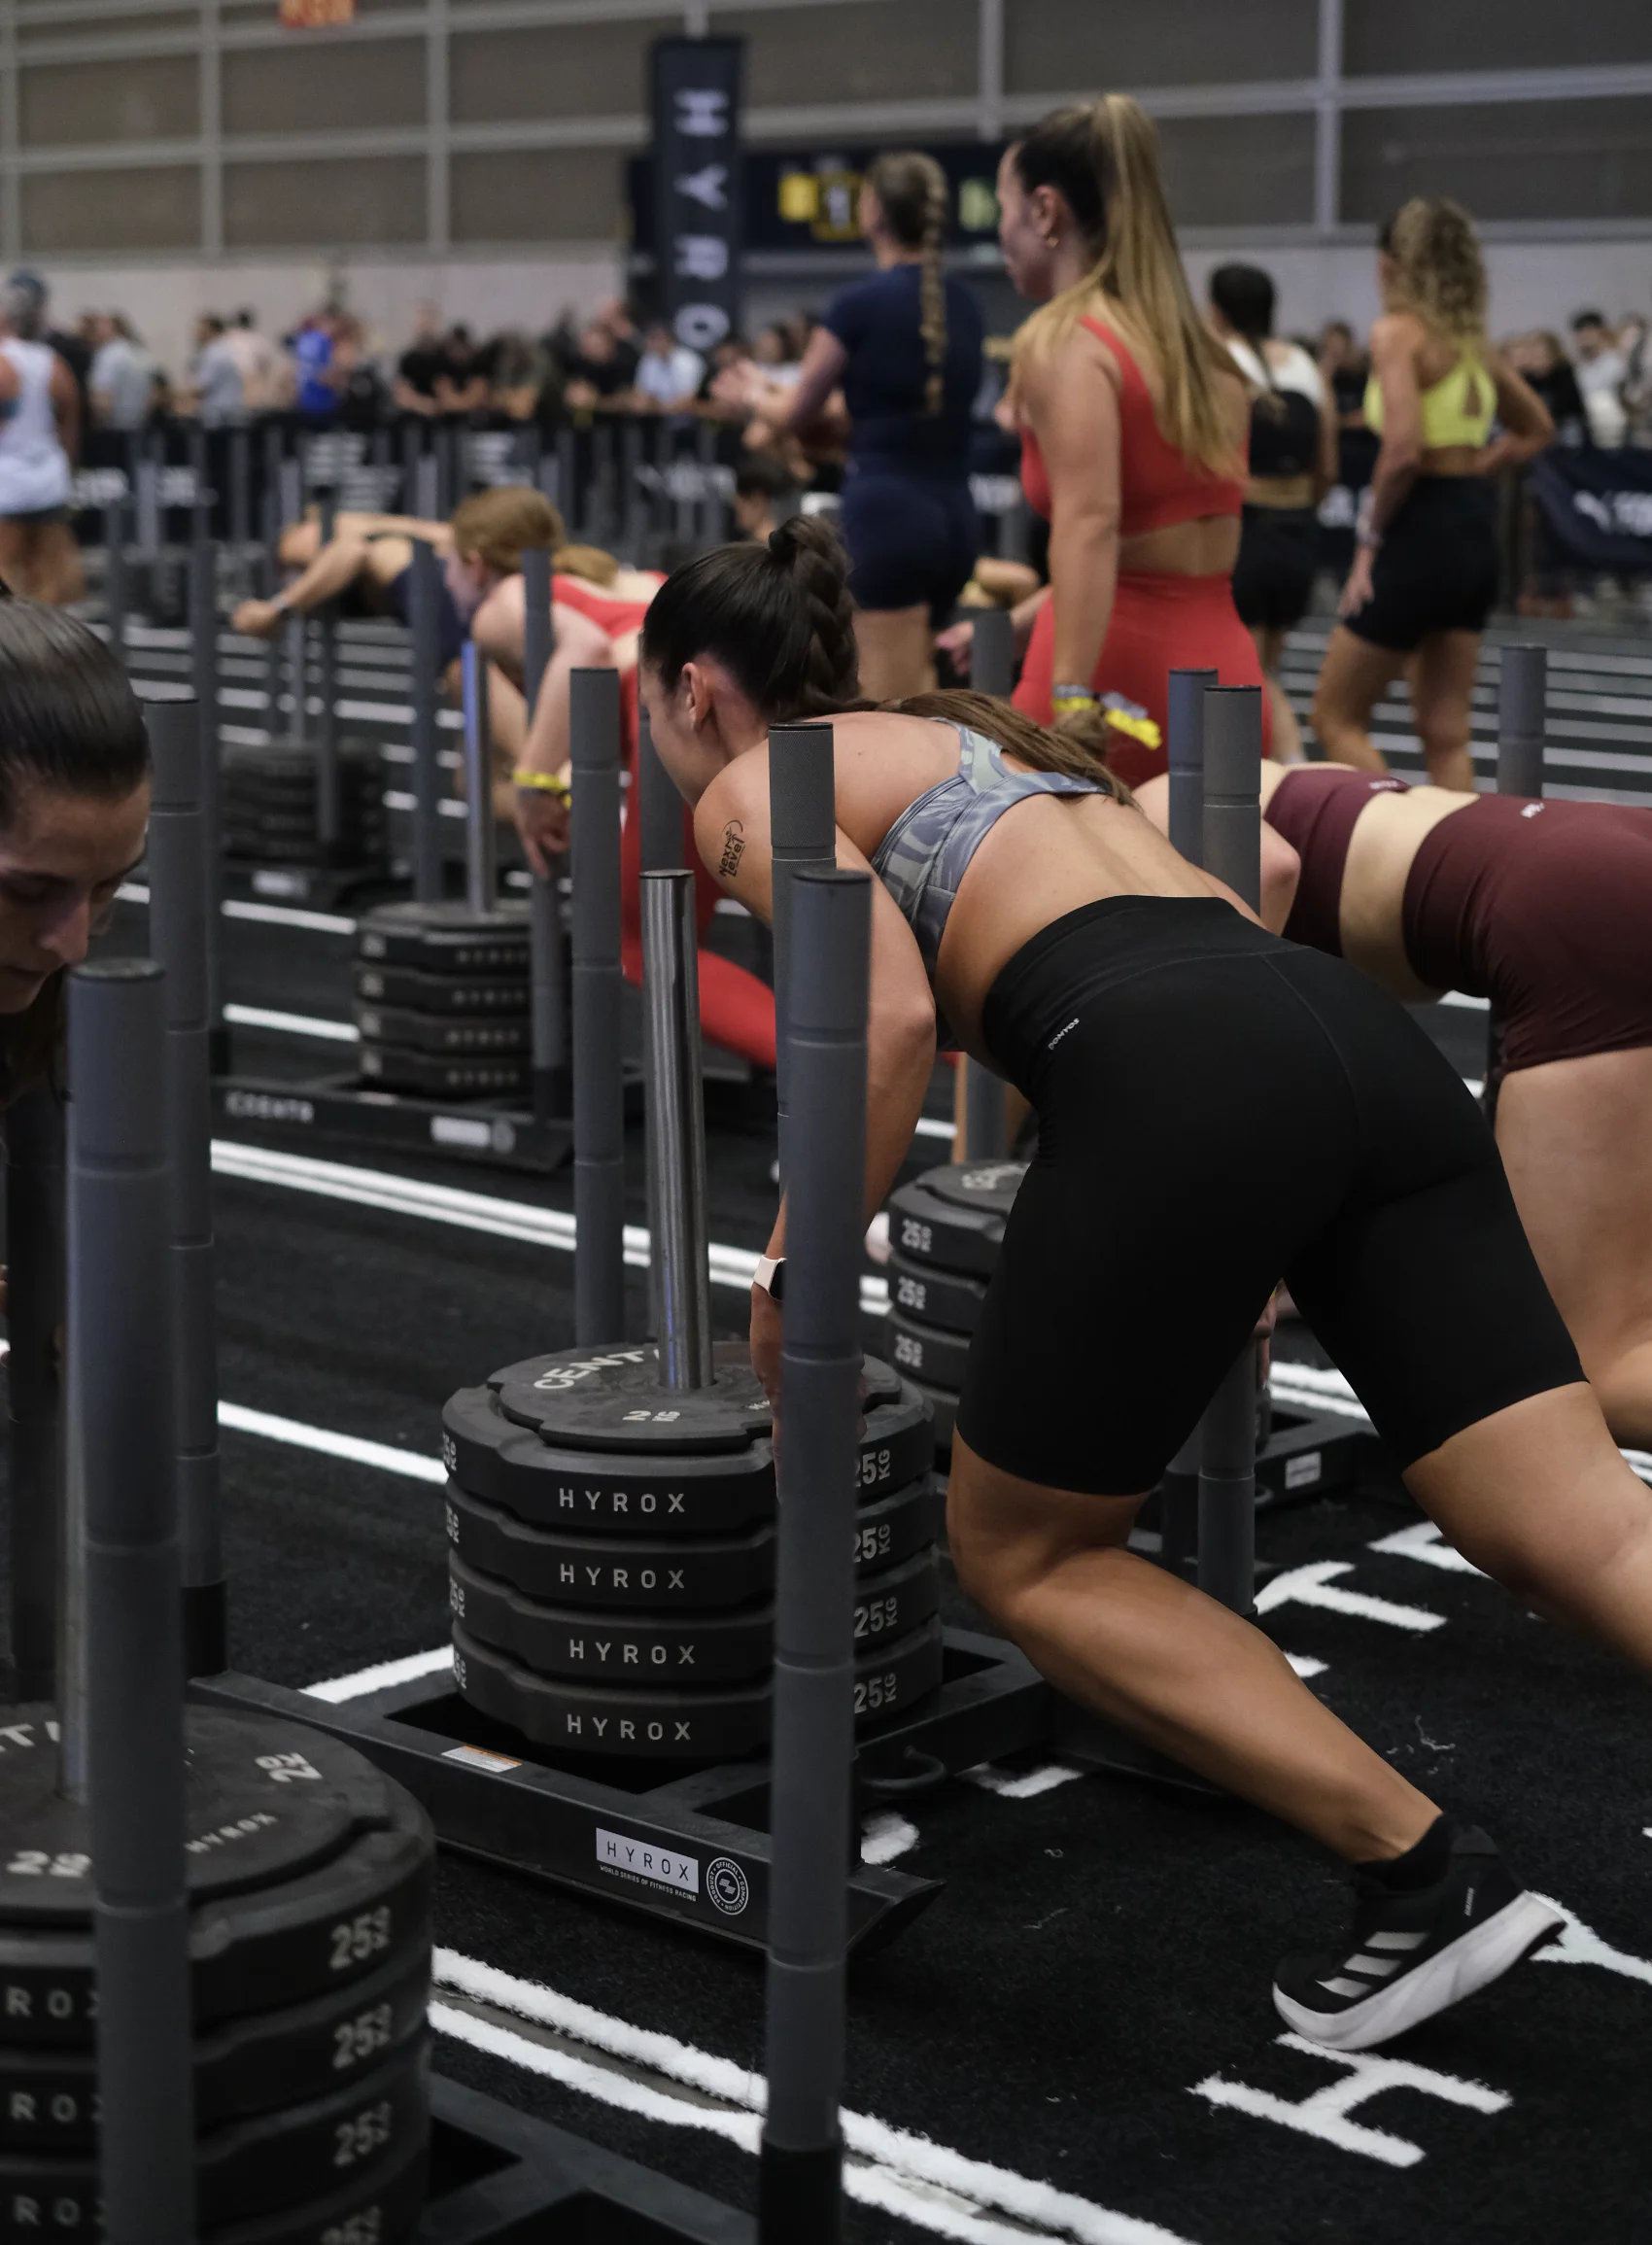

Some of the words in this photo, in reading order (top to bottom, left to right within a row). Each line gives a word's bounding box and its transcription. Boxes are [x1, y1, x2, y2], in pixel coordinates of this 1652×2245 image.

[675, 89, 730, 348] HYRO
[727, 836, 745, 878] Level
[533, 1348, 660, 1390] CENT
[559, 1487, 685, 1513] HYROX
[560, 1563, 685, 1589] HYROX
[569, 1639, 695, 1665] HYROX
[567, 1713, 691, 1741] HYROX
[606, 1841, 689, 1882] HYROX
[715, 1861, 739, 1876] OFFICIAL
[600, 1864, 619, 1876] WORLD
[620, 1871, 639, 1883] SERIES
[649, 1882, 673, 1894] FITNESS
[674, 1889, 697, 1902] RACING
[709, 1870, 721, 1904] PRODUCT
[724, 1881, 746, 1912] COMPETITION
